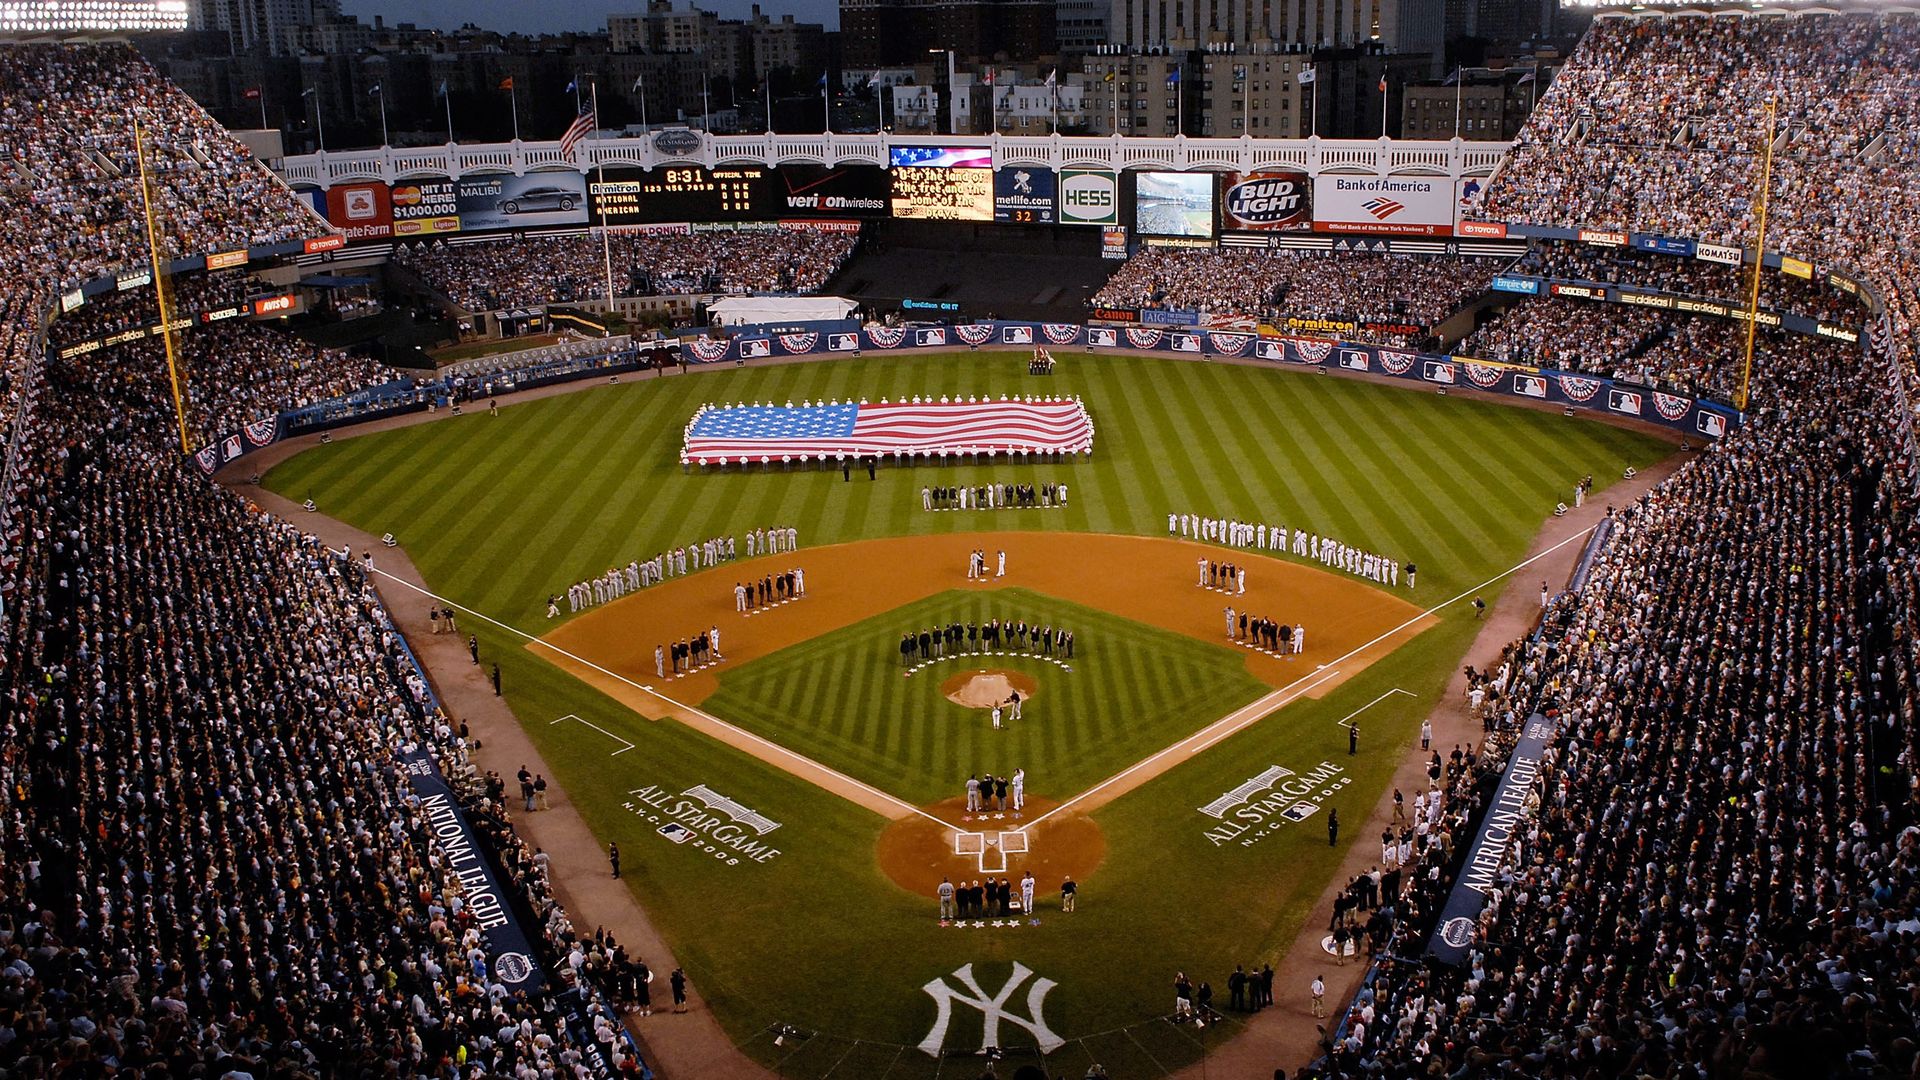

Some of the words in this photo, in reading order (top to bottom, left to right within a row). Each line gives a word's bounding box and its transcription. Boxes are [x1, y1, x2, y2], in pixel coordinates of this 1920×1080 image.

[666, 170, 702, 183] 8:31
[924, 169, 943, 181] the
[945, 170, 968, 182] land
[972, 171, 985, 182] of
[420, 184, 440, 194] HIT
[442, 183, 454, 193] IT
[460, 186, 502, 197] MALIBU
[900, 182, 917, 193] the
[919, 182, 942, 193] free
[944, 182, 964, 194] and
[967, 184, 986, 196] the
[1240, 181, 1294, 200] BUD
[1336, 179, 1366, 190] Bank
[1368, 180, 1380, 190] of
[1381, 180, 1430, 192] America
[421, 193, 456, 204] HERE!
[910, 193, 938, 206] home
[941, 194, 953, 206] of
[956, 195, 974, 207] the
[996, 195, 1052, 206] metlife.com
[1066, 189, 1111, 206] HESS
[1232, 194, 1301, 213] LIGHT
[393, 204, 457, 218] $1,000,000
[397, 224, 420, 232] Lipton
[434, 220, 457, 230] Lipton
[779, 222, 810, 230] SPORTS
[813, 222, 861, 231] AUTHORITY
[1474, 226, 1500, 234] TOYOTA
[344, 226, 362, 238] tate
[1582, 232, 1625, 244] MODELL'S
[318, 240, 340, 248] TOYOTA
[1698, 248, 1740, 261] KOMATSU
[1496, 278, 1522, 290] Empire
[1558, 286, 1590, 298] KYOCERA
[263, 299, 280, 312] AVIS
[1636, 295, 1668, 307] adidas
[1094, 309, 1134, 320] Canon
[1692, 303, 1723, 316] adidas
[1147, 312, 1166, 323] AIG
[1207, 315, 1246, 326] Budweiser
[1288, 318, 1354, 331] Armitron
[1365, 323, 1420, 335] SHARP
[73, 340, 100, 355] adidas
[1312, 777, 1352, 803] 2008
[1203, 820, 1250, 847] ALL
[1236, 793, 1296, 824] STAR
[1281, 760, 1344, 796] GAME
[628, 784, 674, 808] ALL
[664, 800, 720, 834] STAR
[712, 825, 782, 864] GAME
[1464, 812, 1520, 894] AMERICAN
[1511, 756, 1541, 814] LEAGUE
[692, 840, 740, 866] 2008
[421, 793, 476, 868] NATIONAL
[456, 864, 508, 931] LEAGUE
